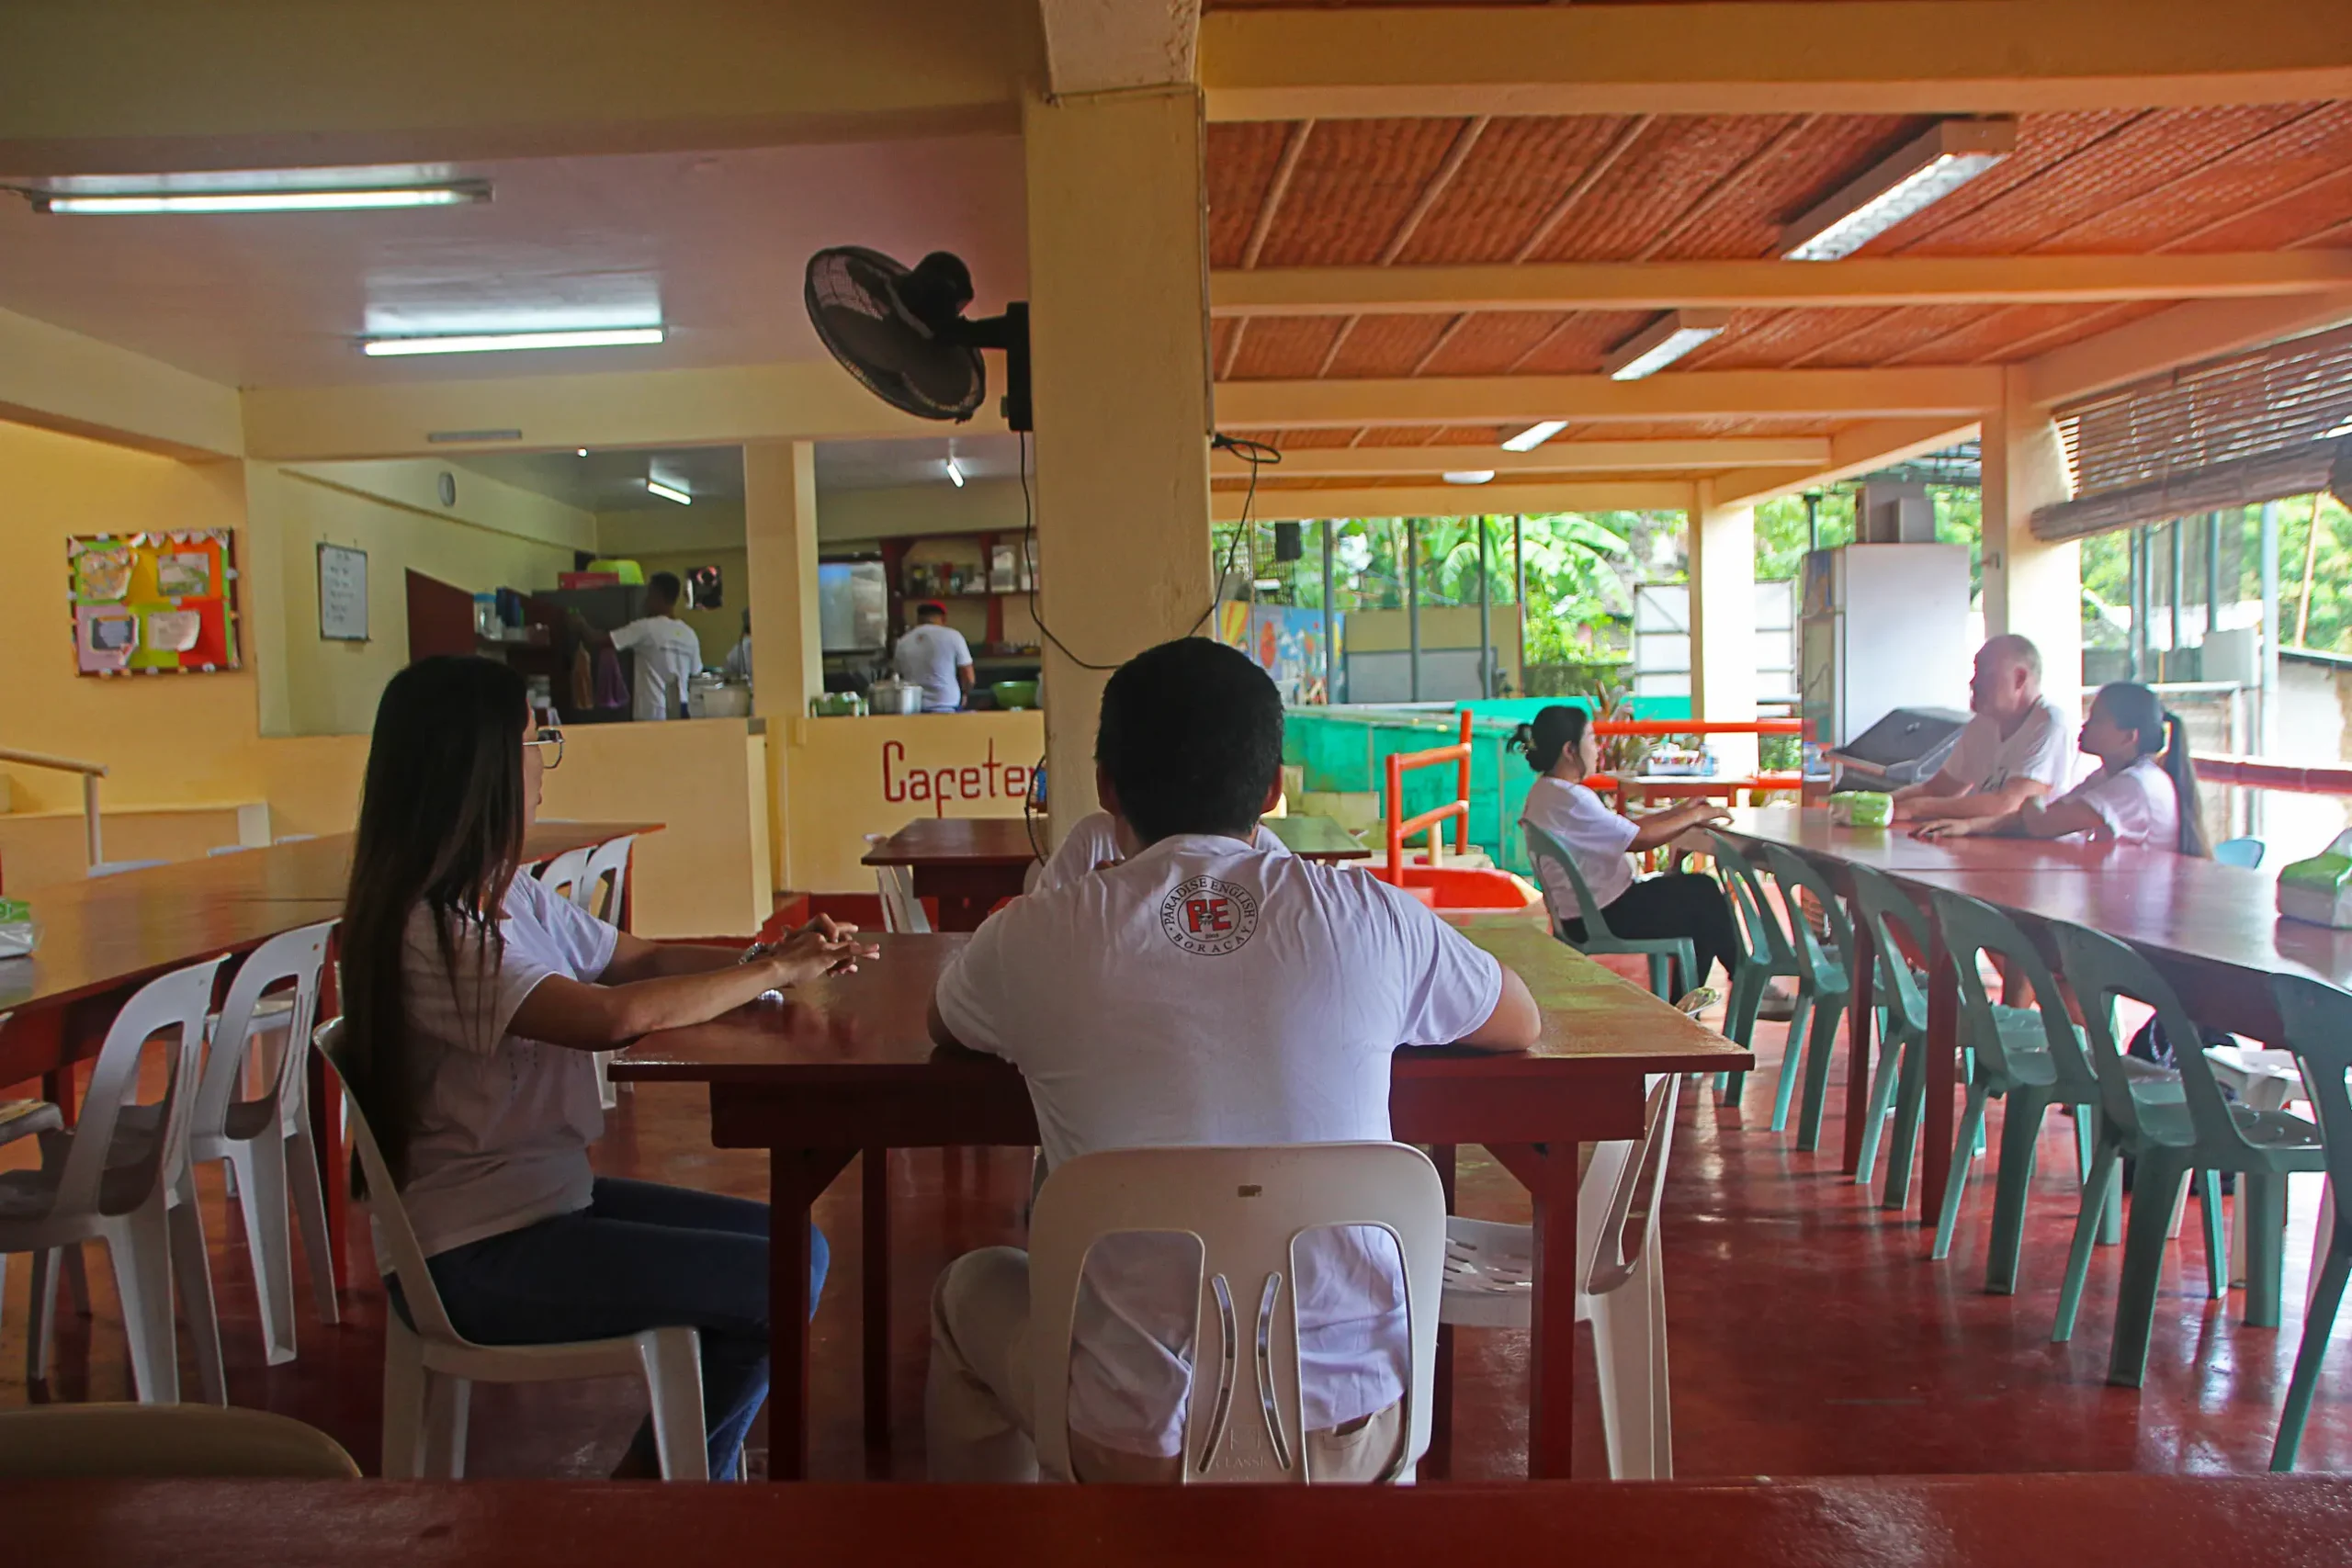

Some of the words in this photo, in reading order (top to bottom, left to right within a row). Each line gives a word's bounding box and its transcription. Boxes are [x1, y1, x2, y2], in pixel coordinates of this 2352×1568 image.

[1164, 878, 1208, 925] PARADISE
[1210, 879, 1256, 919] ENGLISH
[1173, 926, 1251, 953] BORACAY
